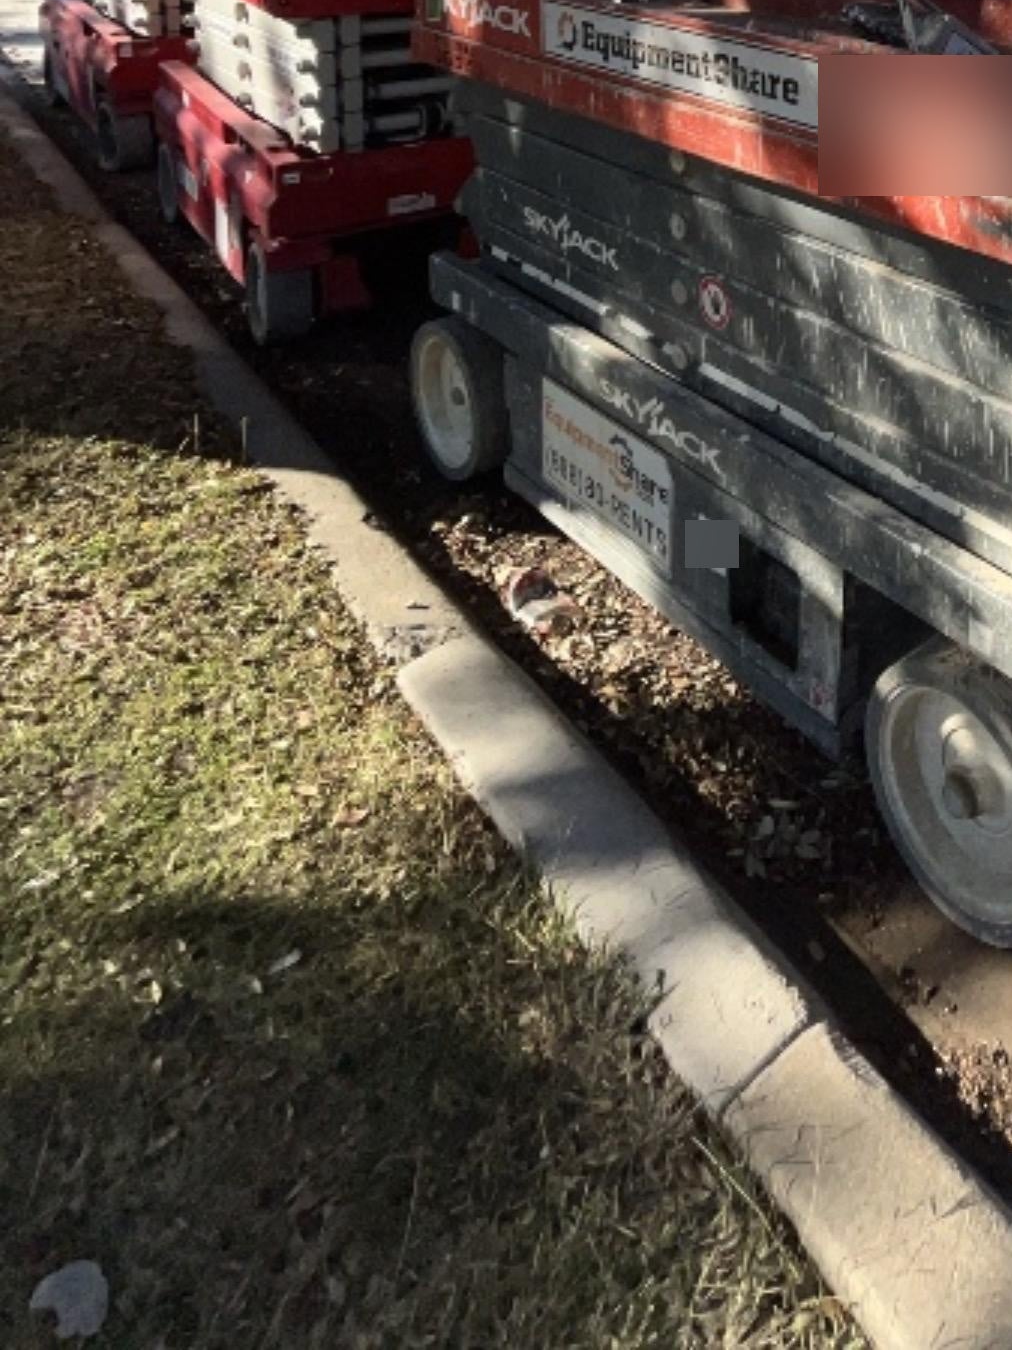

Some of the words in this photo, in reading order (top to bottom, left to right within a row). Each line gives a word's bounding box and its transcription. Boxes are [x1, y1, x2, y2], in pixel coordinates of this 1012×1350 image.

[581, 20, 800, 105] EquipmentShare
[523, 205, 620, 272] SKYJACK
[600, 379, 728, 488] SKYJACK
